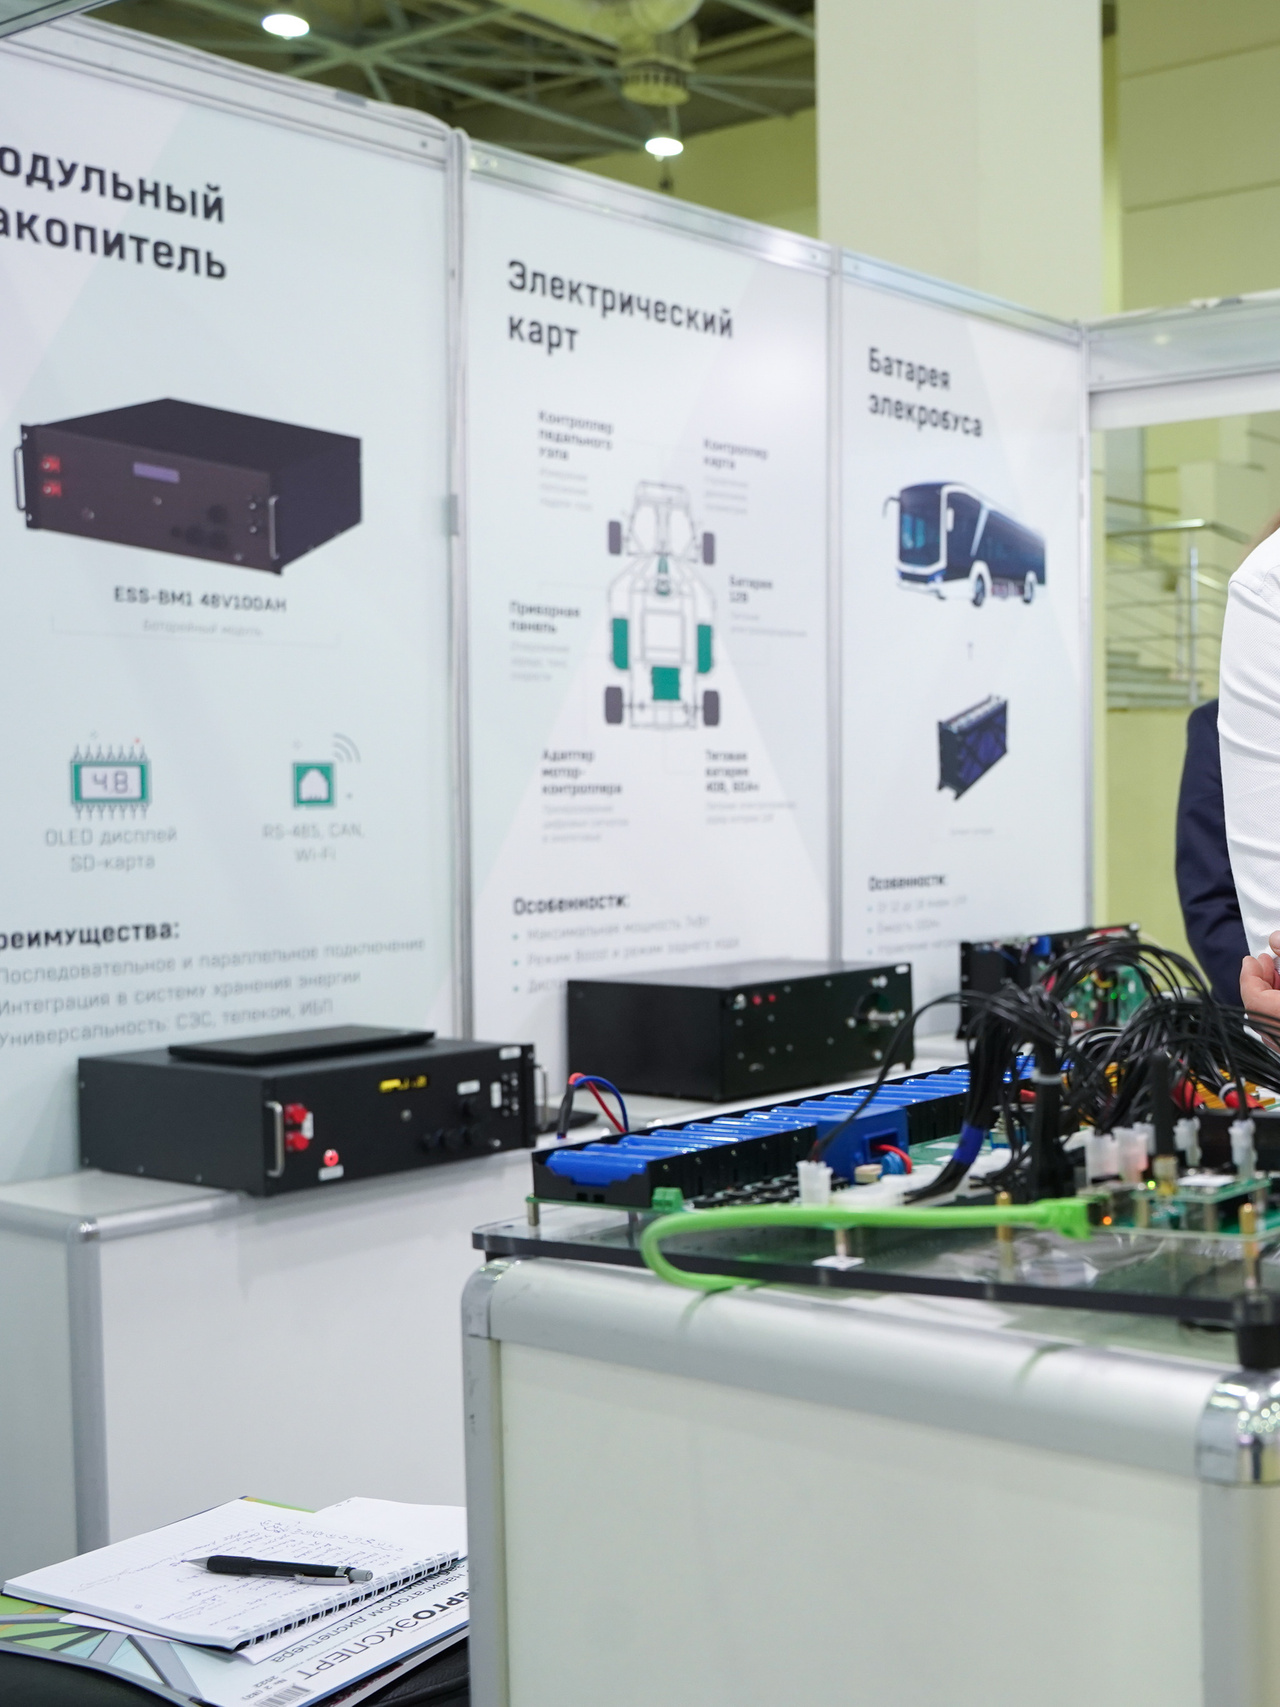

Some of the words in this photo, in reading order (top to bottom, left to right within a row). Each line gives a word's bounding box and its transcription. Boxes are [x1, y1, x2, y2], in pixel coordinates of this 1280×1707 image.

[0, 146, 225, 223] одульный
[507, 259, 734, 338] Электрический
[507, 314, 579, 356] карт
[867, 347, 951, 390] Батарея
[538, 410, 614, 435] Контроллер
[867, 392, 983, 437] элекробуса
[115, 585, 192, 607] ESS-BM1
[200, 591, 288, 613] 48V100AH
[541, 749, 595, 764] Адаптер
[45, 827, 93, 847] OLED
[101, 826, 178, 846] дисплей
[71, 854, 156, 873] SD-карта
[199, 946, 319, 970] параллельное
[135, 984, 207, 1004] систему
[213, 976, 292, 999] хранения
[299, 970, 361, 989] энергии
[368, 1573, 465, 1618] навигатором
[272, 1616, 366, 1663] диспетчера
[297, 1589, 468, 1680] ЕРГОЭКСПЕРТ
